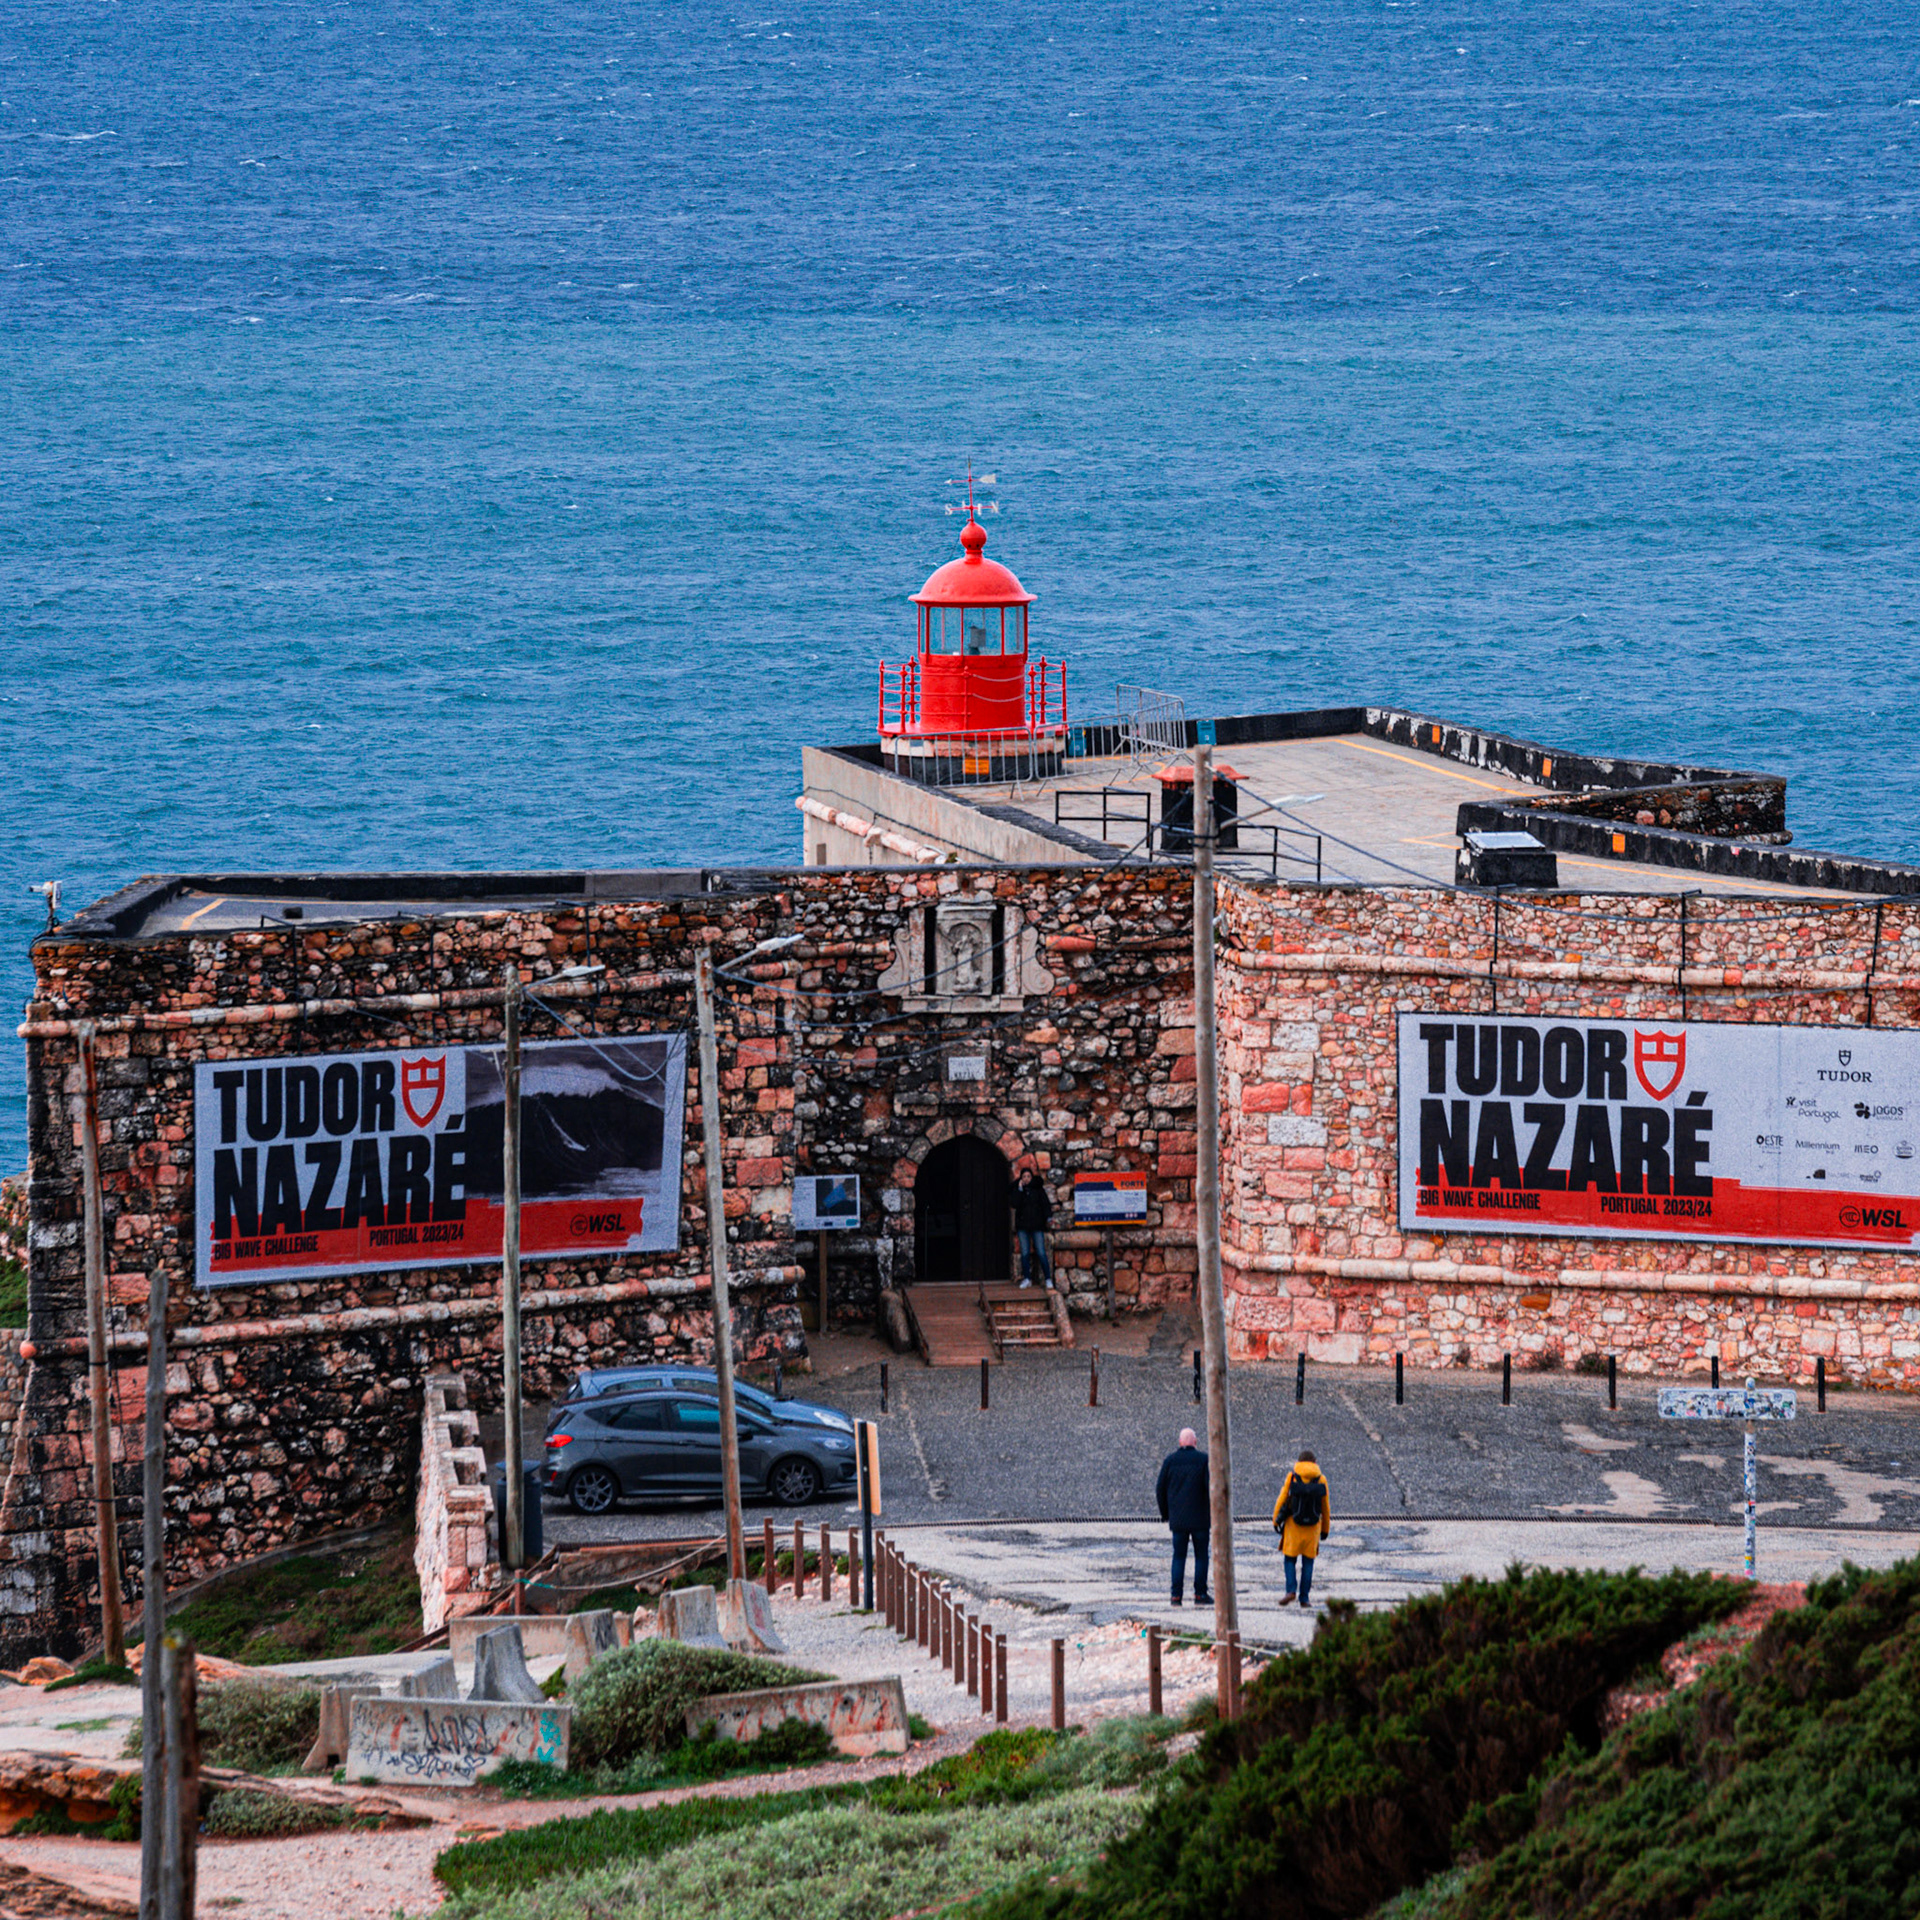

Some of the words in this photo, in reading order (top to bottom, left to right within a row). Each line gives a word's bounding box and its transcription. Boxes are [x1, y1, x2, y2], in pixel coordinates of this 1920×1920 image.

[1419, 1023, 1627, 1100] TUDOR
[1817, 1070, 1872, 1083] TUDOR
[213, 1060, 396, 1143] TUDOR
[1799, 1099, 1817, 1107] visit
[1872, 1105, 1904, 1117] JOGOS
[1798, 1107, 1841, 1123] Portugal
[1419, 1091, 1713, 1197] NAZARÉ
[1756, 1135, 1784, 1146] OESTE
[1795, 1139, 1840, 1150] Millennium
[1854, 1144, 1879, 1154] MEO
[213, 1114, 466, 1240] NAZARÉ
[1420, 1189, 1439, 1206] BIG
[1443, 1190, 1474, 1208] WAVE
[1478, 1191, 1541, 1210] CHALLENGE
[1601, 1196, 1660, 1215] PORTUGAL
[1663, 1199, 1712, 1219] 2023/24
[589, 1213, 626, 1233] WSL
[1862, 1208, 1907, 1228] WSL
[369, 1226, 419, 1247] PORTUGAL
[422, 1222, 464, 1244] 2023/24
[214, 1242, 231, 1260] BIG
[234, 1240, 261, 1259] WAVE
[264, 1235, 319, 1256] CHALLENGE
